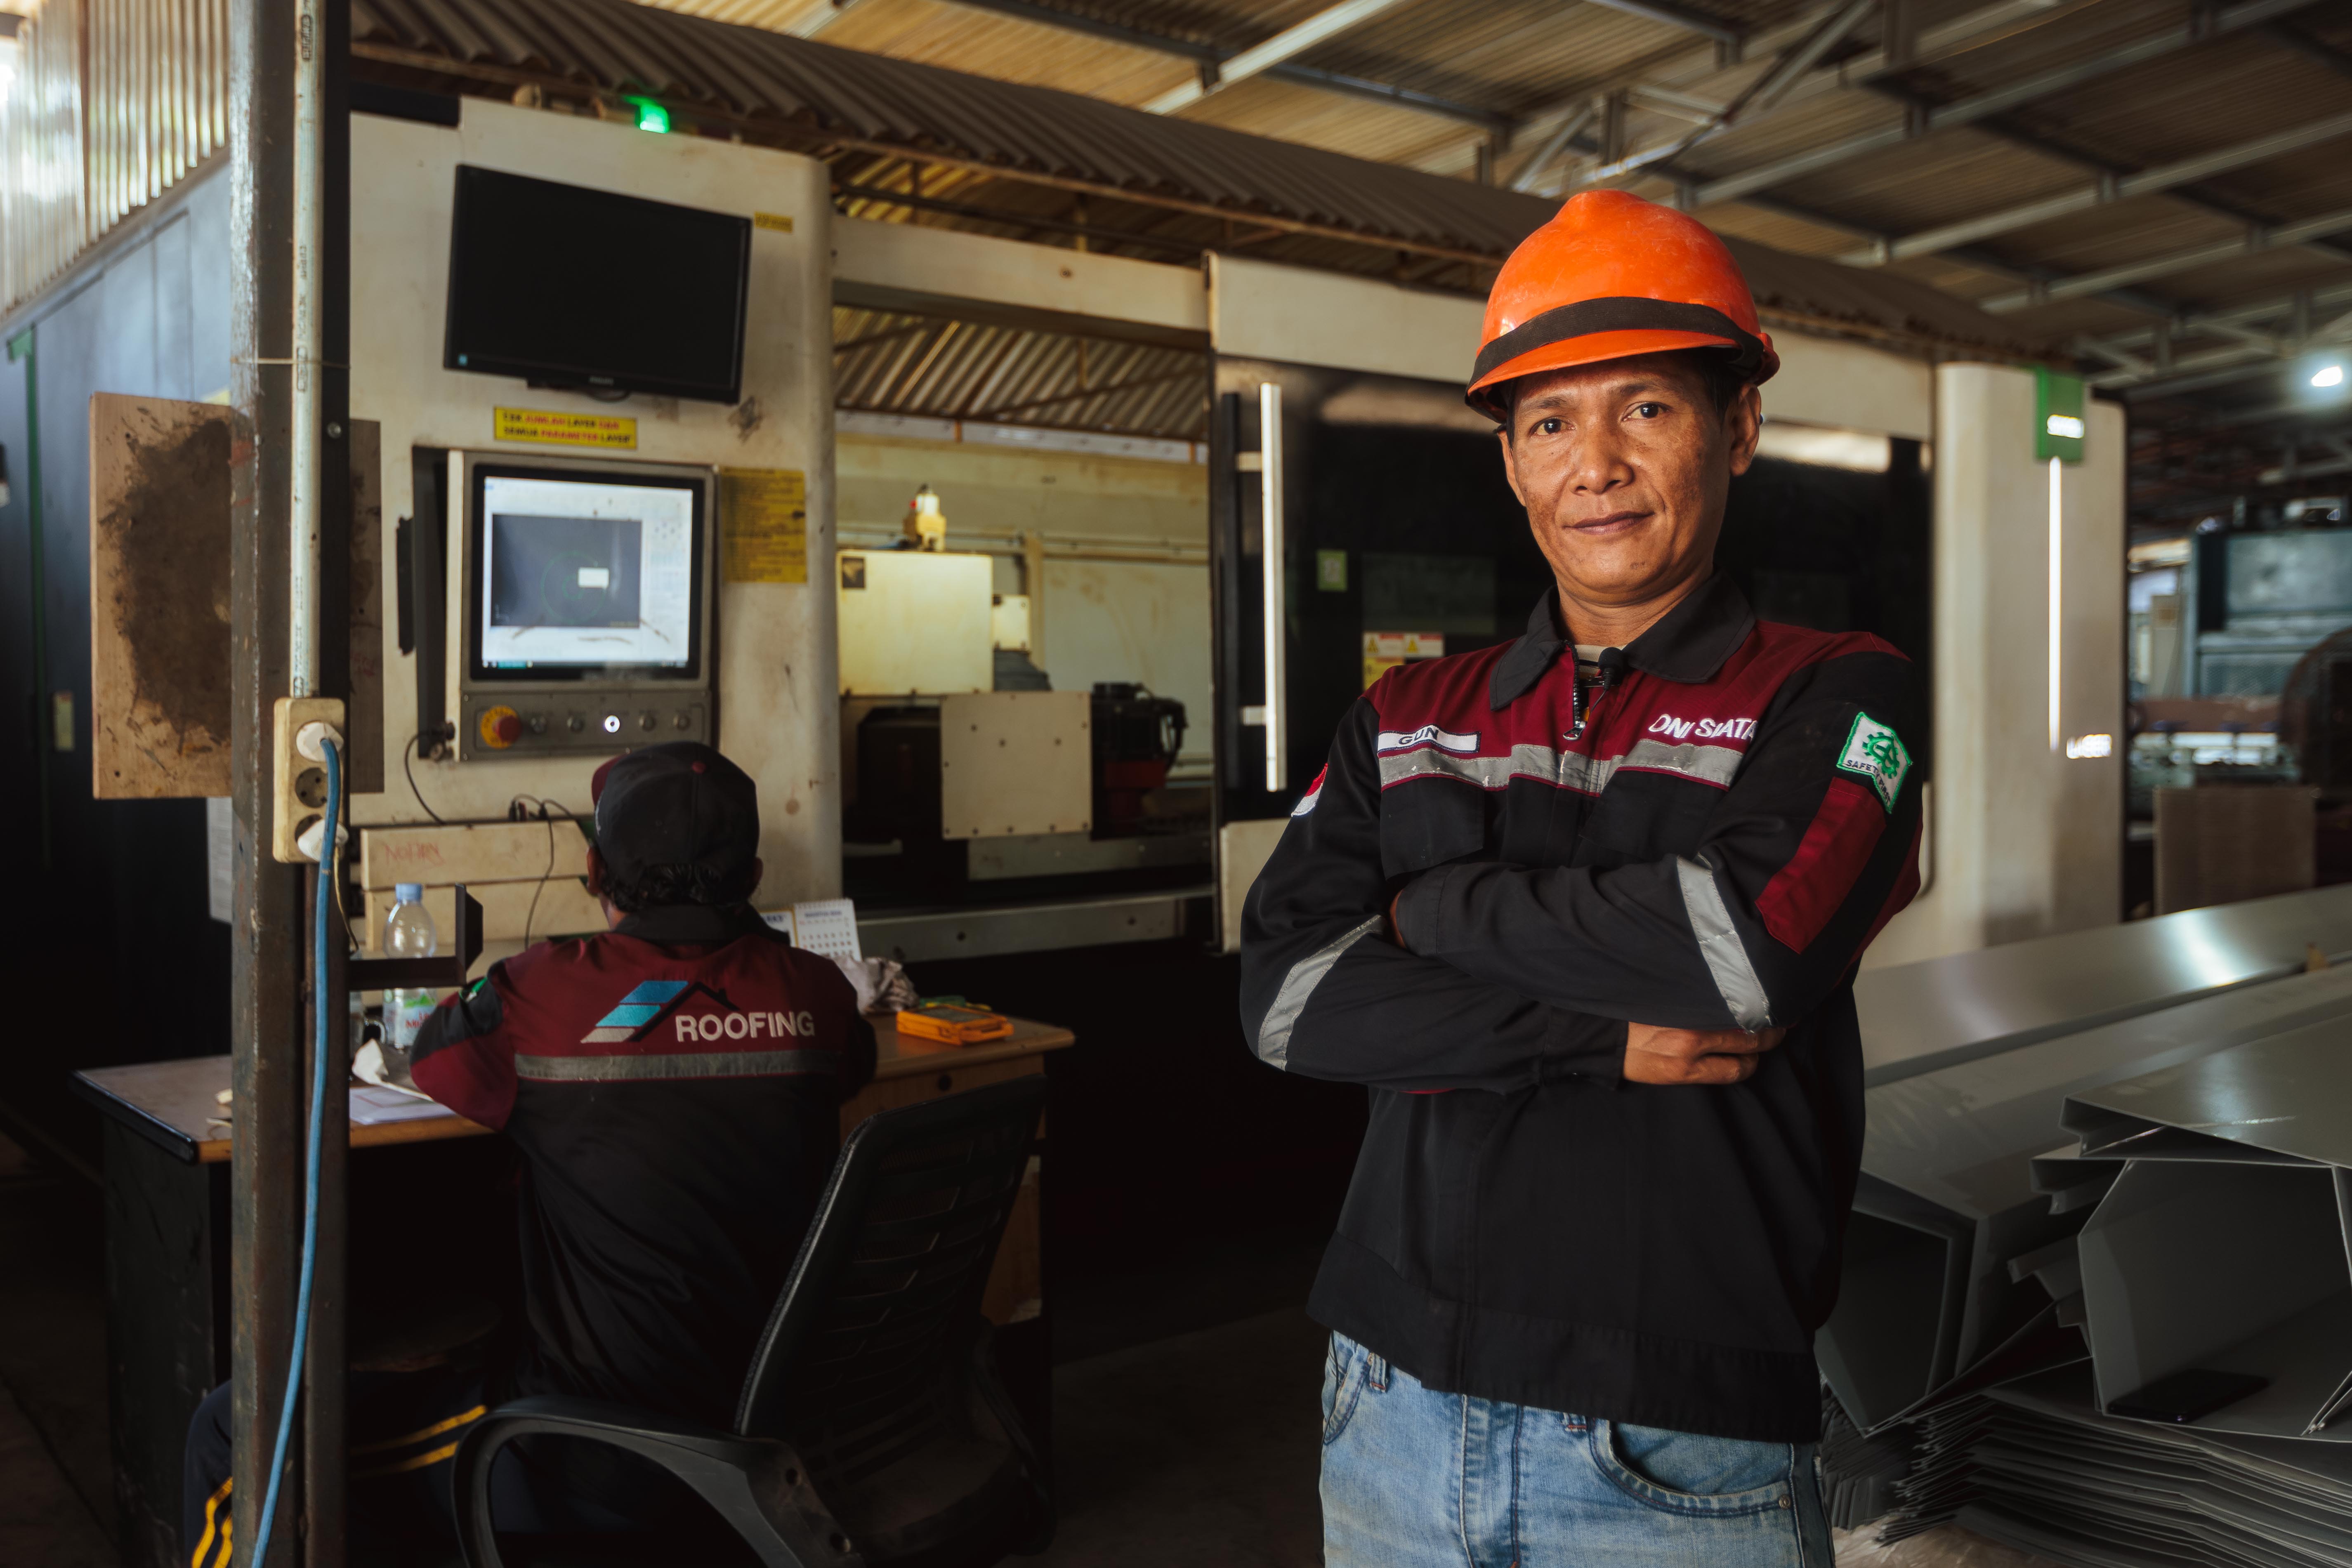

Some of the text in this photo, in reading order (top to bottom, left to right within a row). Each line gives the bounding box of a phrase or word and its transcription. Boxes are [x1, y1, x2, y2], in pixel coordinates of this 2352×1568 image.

[568, 418, 595, 428] LAYER
[1398, 727, 1439, 745] GUN
[675, 1010, 815, 1042] ROOFING
